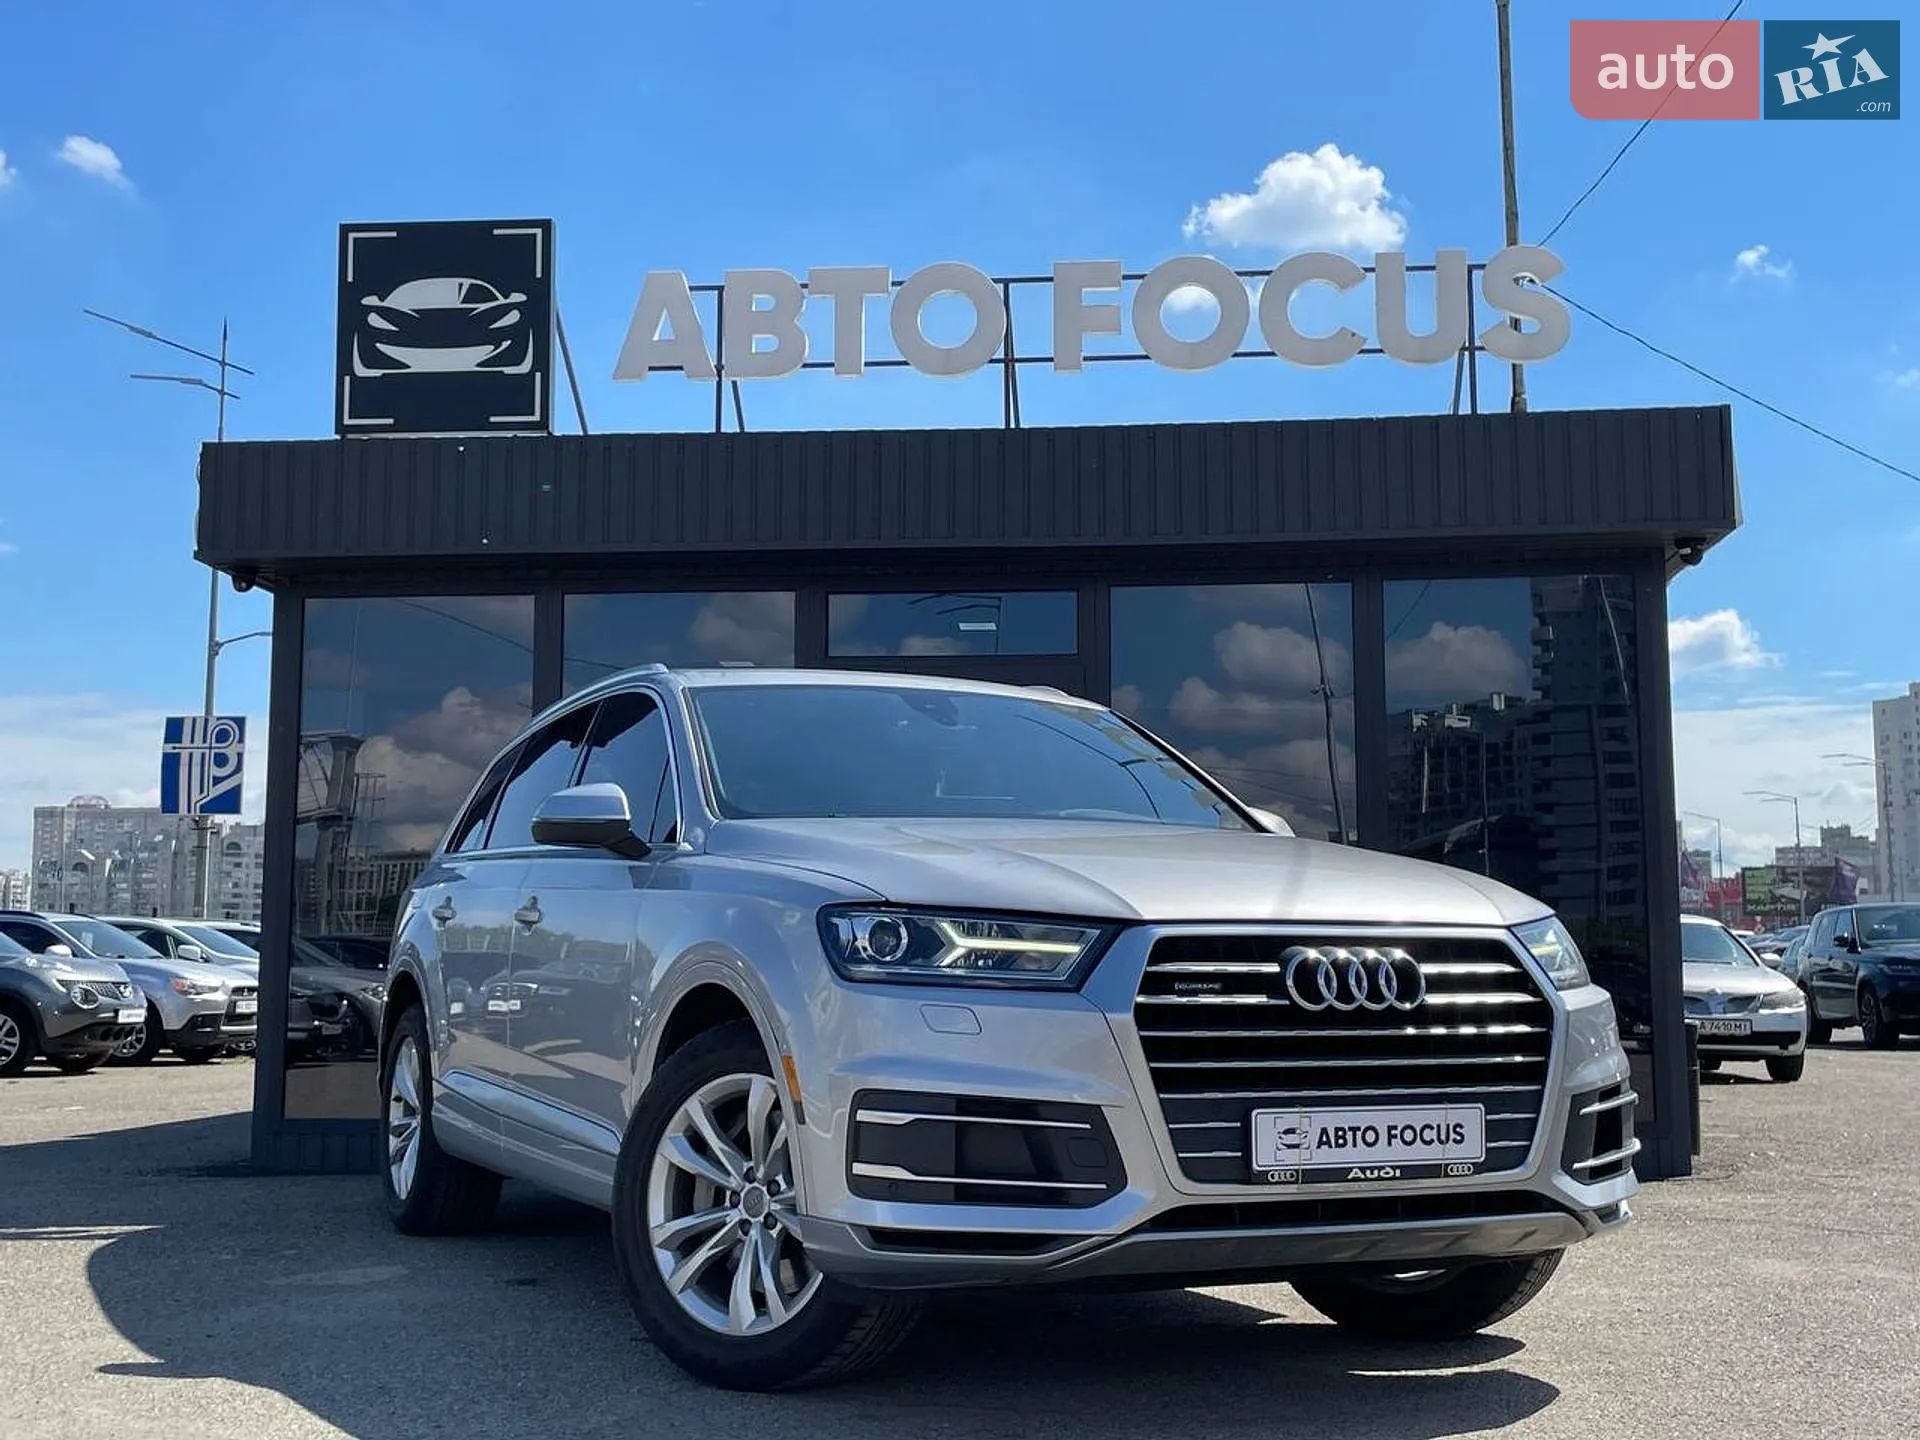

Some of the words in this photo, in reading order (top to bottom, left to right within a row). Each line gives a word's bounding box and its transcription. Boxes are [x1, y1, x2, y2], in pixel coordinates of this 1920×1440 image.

[612, 261, 1006, 382] АВТО
[1053, 247, 1571, 371] FOCUS
[1316, 1125, 1380, 1149] АВТО
[1387, 1123, 1466, 1147] FOCUS
[1346, 1166, 1401, 1179] Audi
